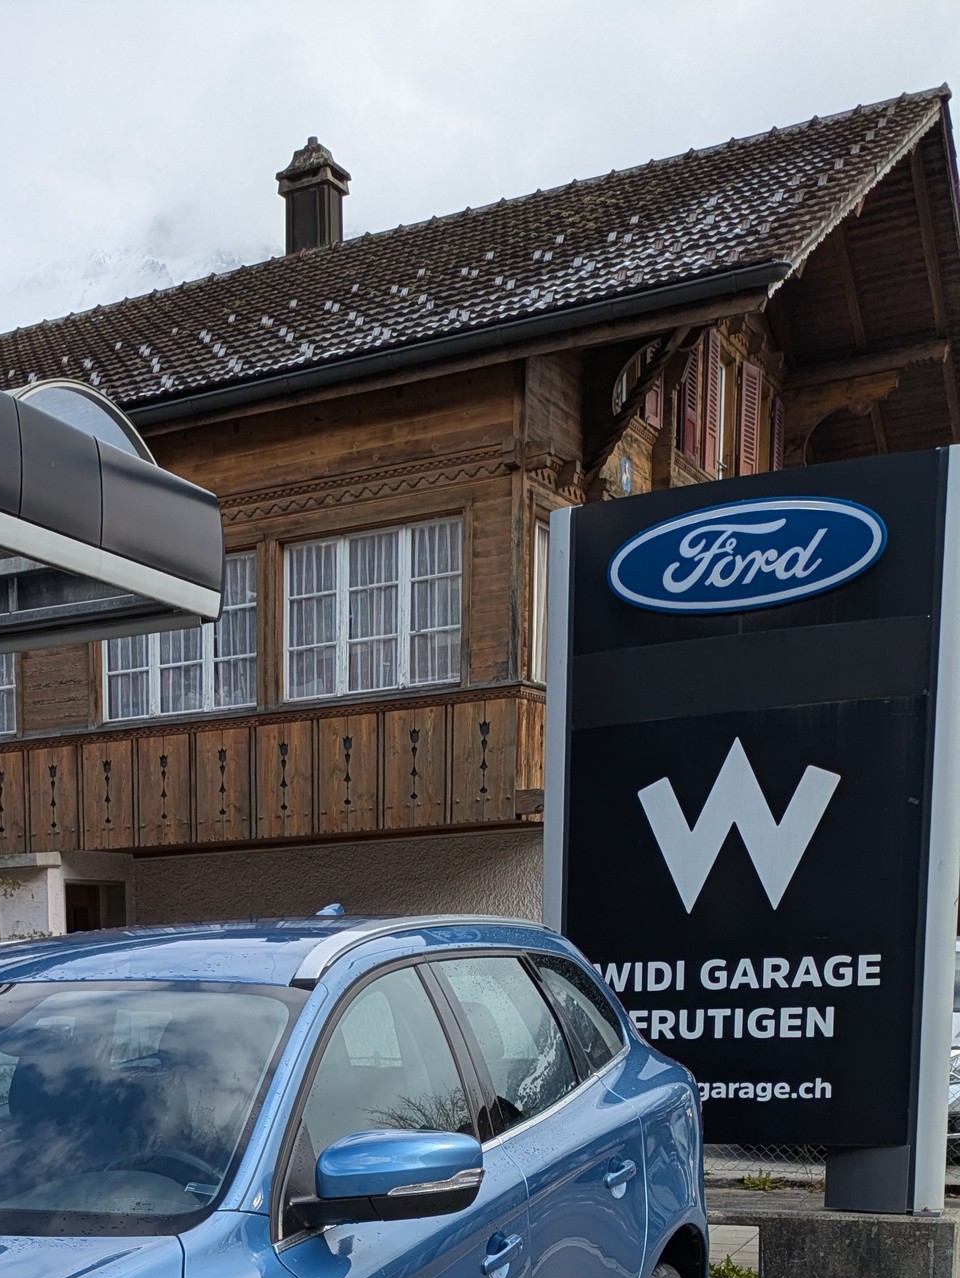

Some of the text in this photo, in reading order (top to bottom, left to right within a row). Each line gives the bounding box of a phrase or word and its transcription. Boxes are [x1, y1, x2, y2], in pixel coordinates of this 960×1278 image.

[662, 518, 828, 594] Ford
[637, 737, 841, 914] W
[593, 954, 882, 992] WIDI GARAGE
[629, 1006, 835, 1040] FRUTIGEN
